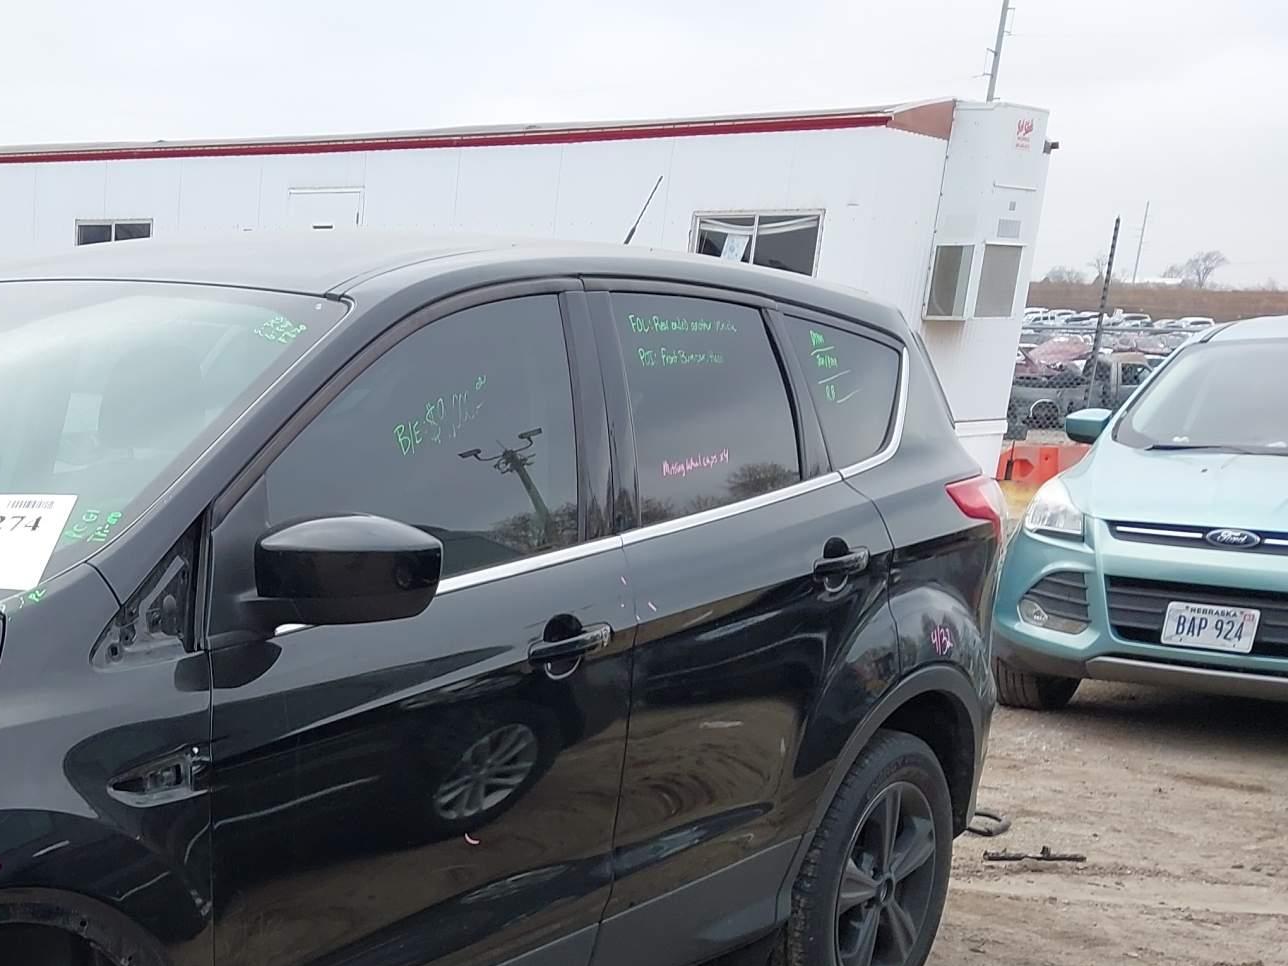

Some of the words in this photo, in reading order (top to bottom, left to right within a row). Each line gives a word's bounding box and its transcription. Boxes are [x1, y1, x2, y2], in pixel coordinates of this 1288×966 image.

[1190, 607, 1238, 618] NEBRASKA
[1175, 615, 1208, 638] BAP
[1214, 619, 1245, 643] 924
